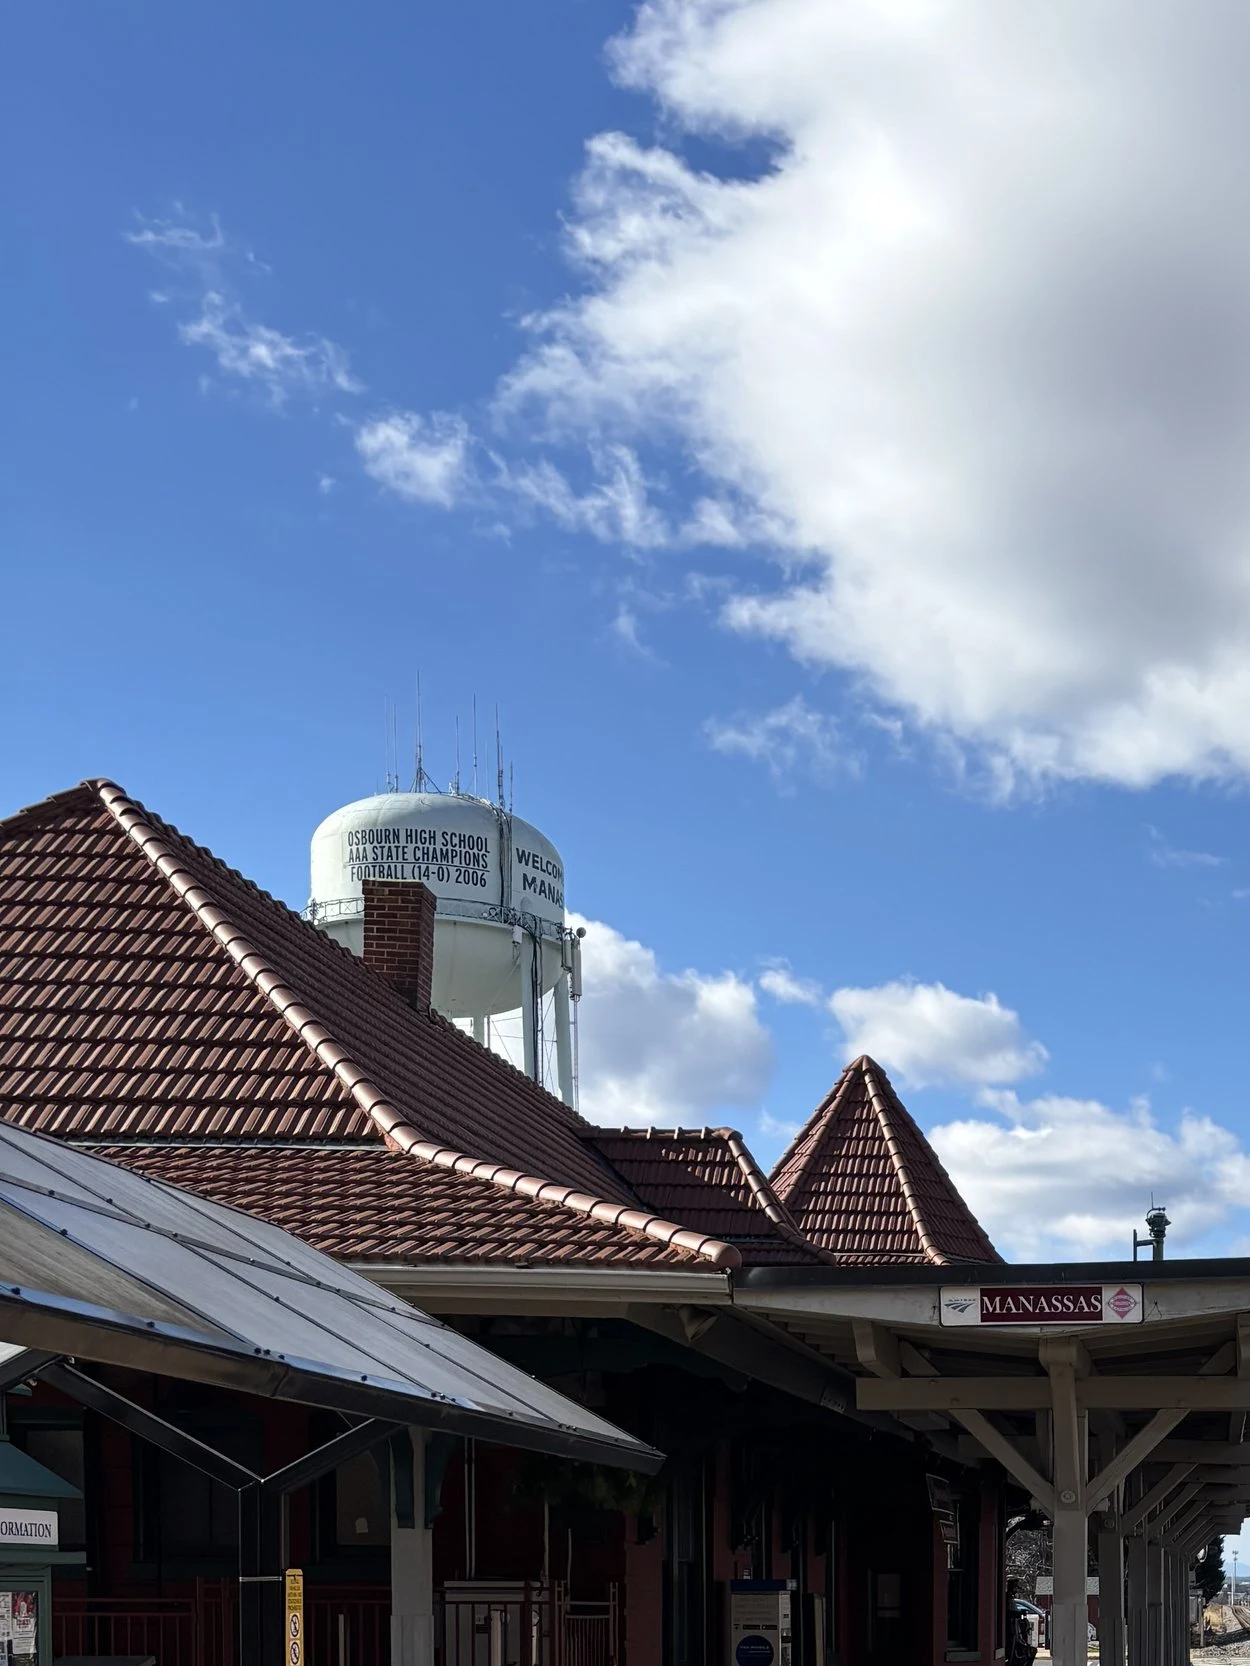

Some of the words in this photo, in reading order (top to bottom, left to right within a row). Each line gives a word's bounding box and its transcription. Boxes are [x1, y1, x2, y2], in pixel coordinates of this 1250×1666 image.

[348, 828, 400, 847] OSBOURN
[405, 828, 436, 846] HIGH
[441, 831, 490, 853] SCHOOL
[348, 846, 368, 863] AAA
[372, 845, 408, 861] STATE
[413, 846, 488, 869] CHAMPIONS
[515, 847, 565, 882] WELCOM
[351, 864, 407, 882] FOOTBALL
[412, 864, 450, 883] (14-0)
[455, 868, 487, 887] 2006
[981, 1294, 1102, 1314] MANASSAS
[0, 1521, 52, 1538] ORMATION
